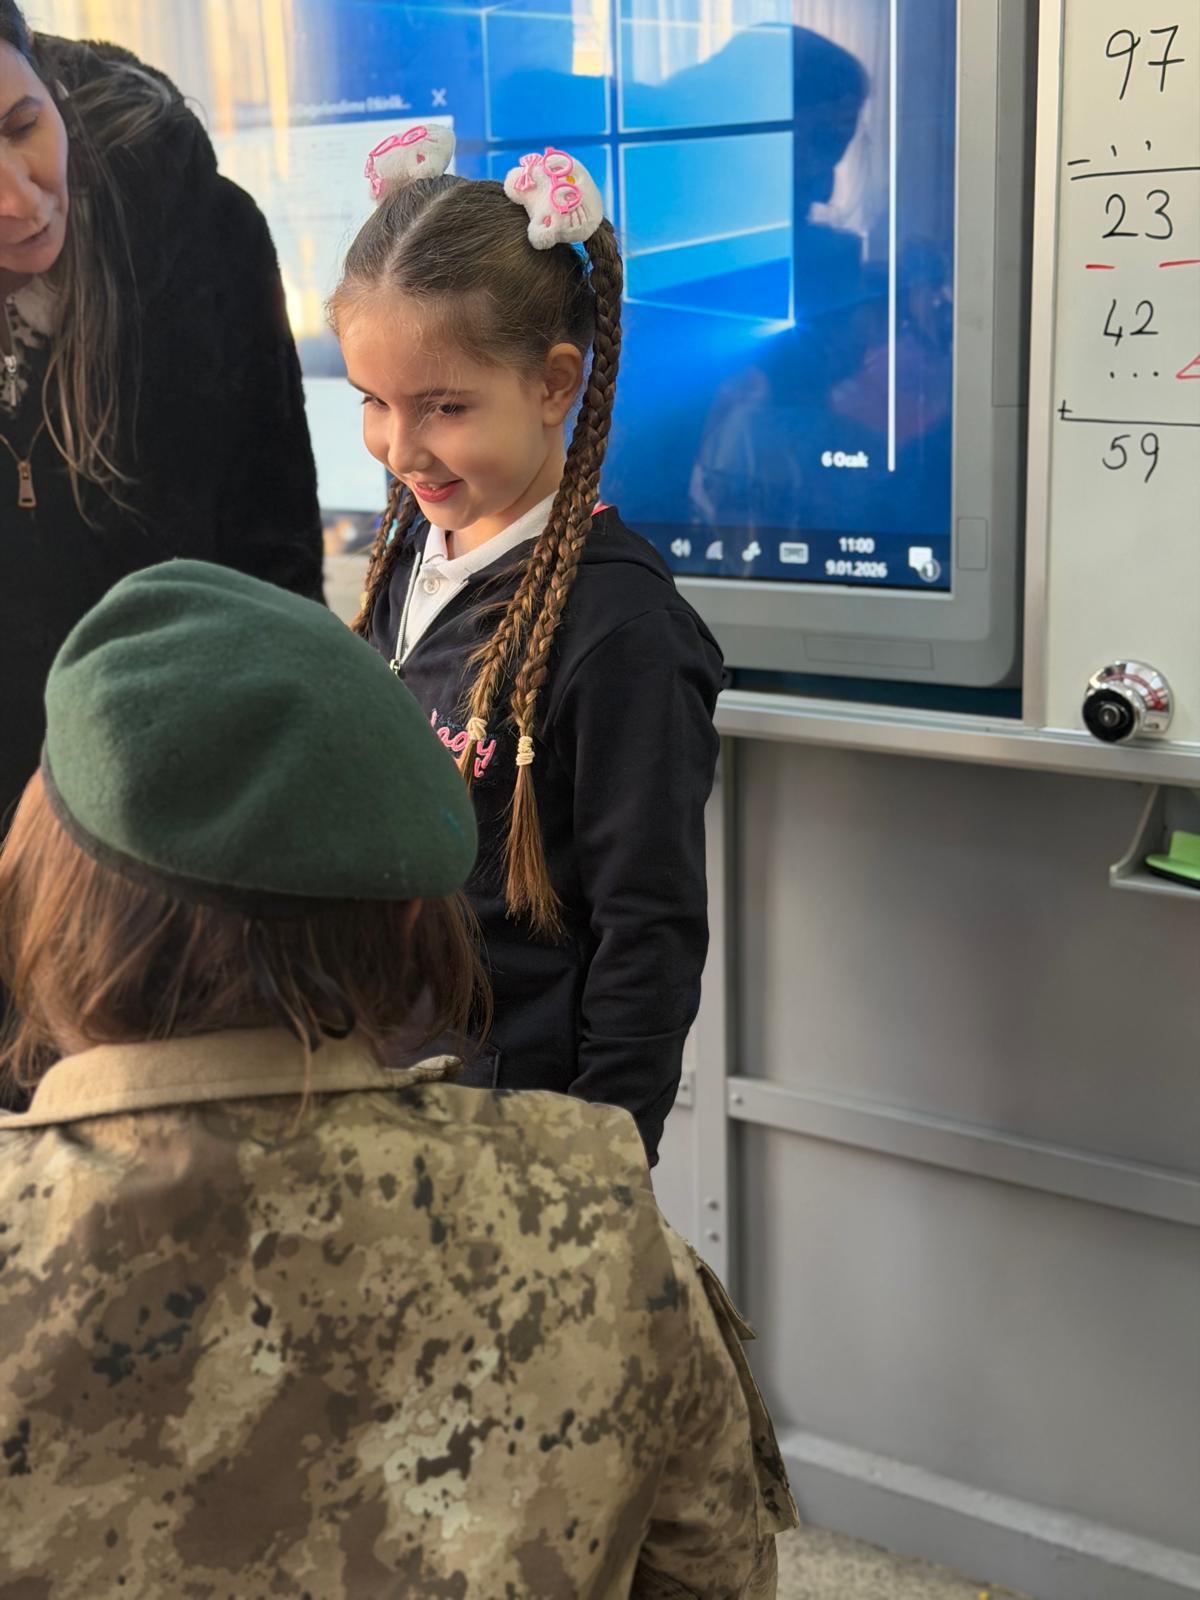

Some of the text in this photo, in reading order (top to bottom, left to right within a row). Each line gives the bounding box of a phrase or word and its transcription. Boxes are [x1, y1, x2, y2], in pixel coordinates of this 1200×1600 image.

[1105, 25, 1185, 101] 97
[1102, 189, 1173, 240] 23
[1103, 299, 1159, 347] 42
[1102, 432, 1160, 484] 59
[825, 560, 888, 578] 9.01.2026
[839, 537, 876, 554] 11:00
